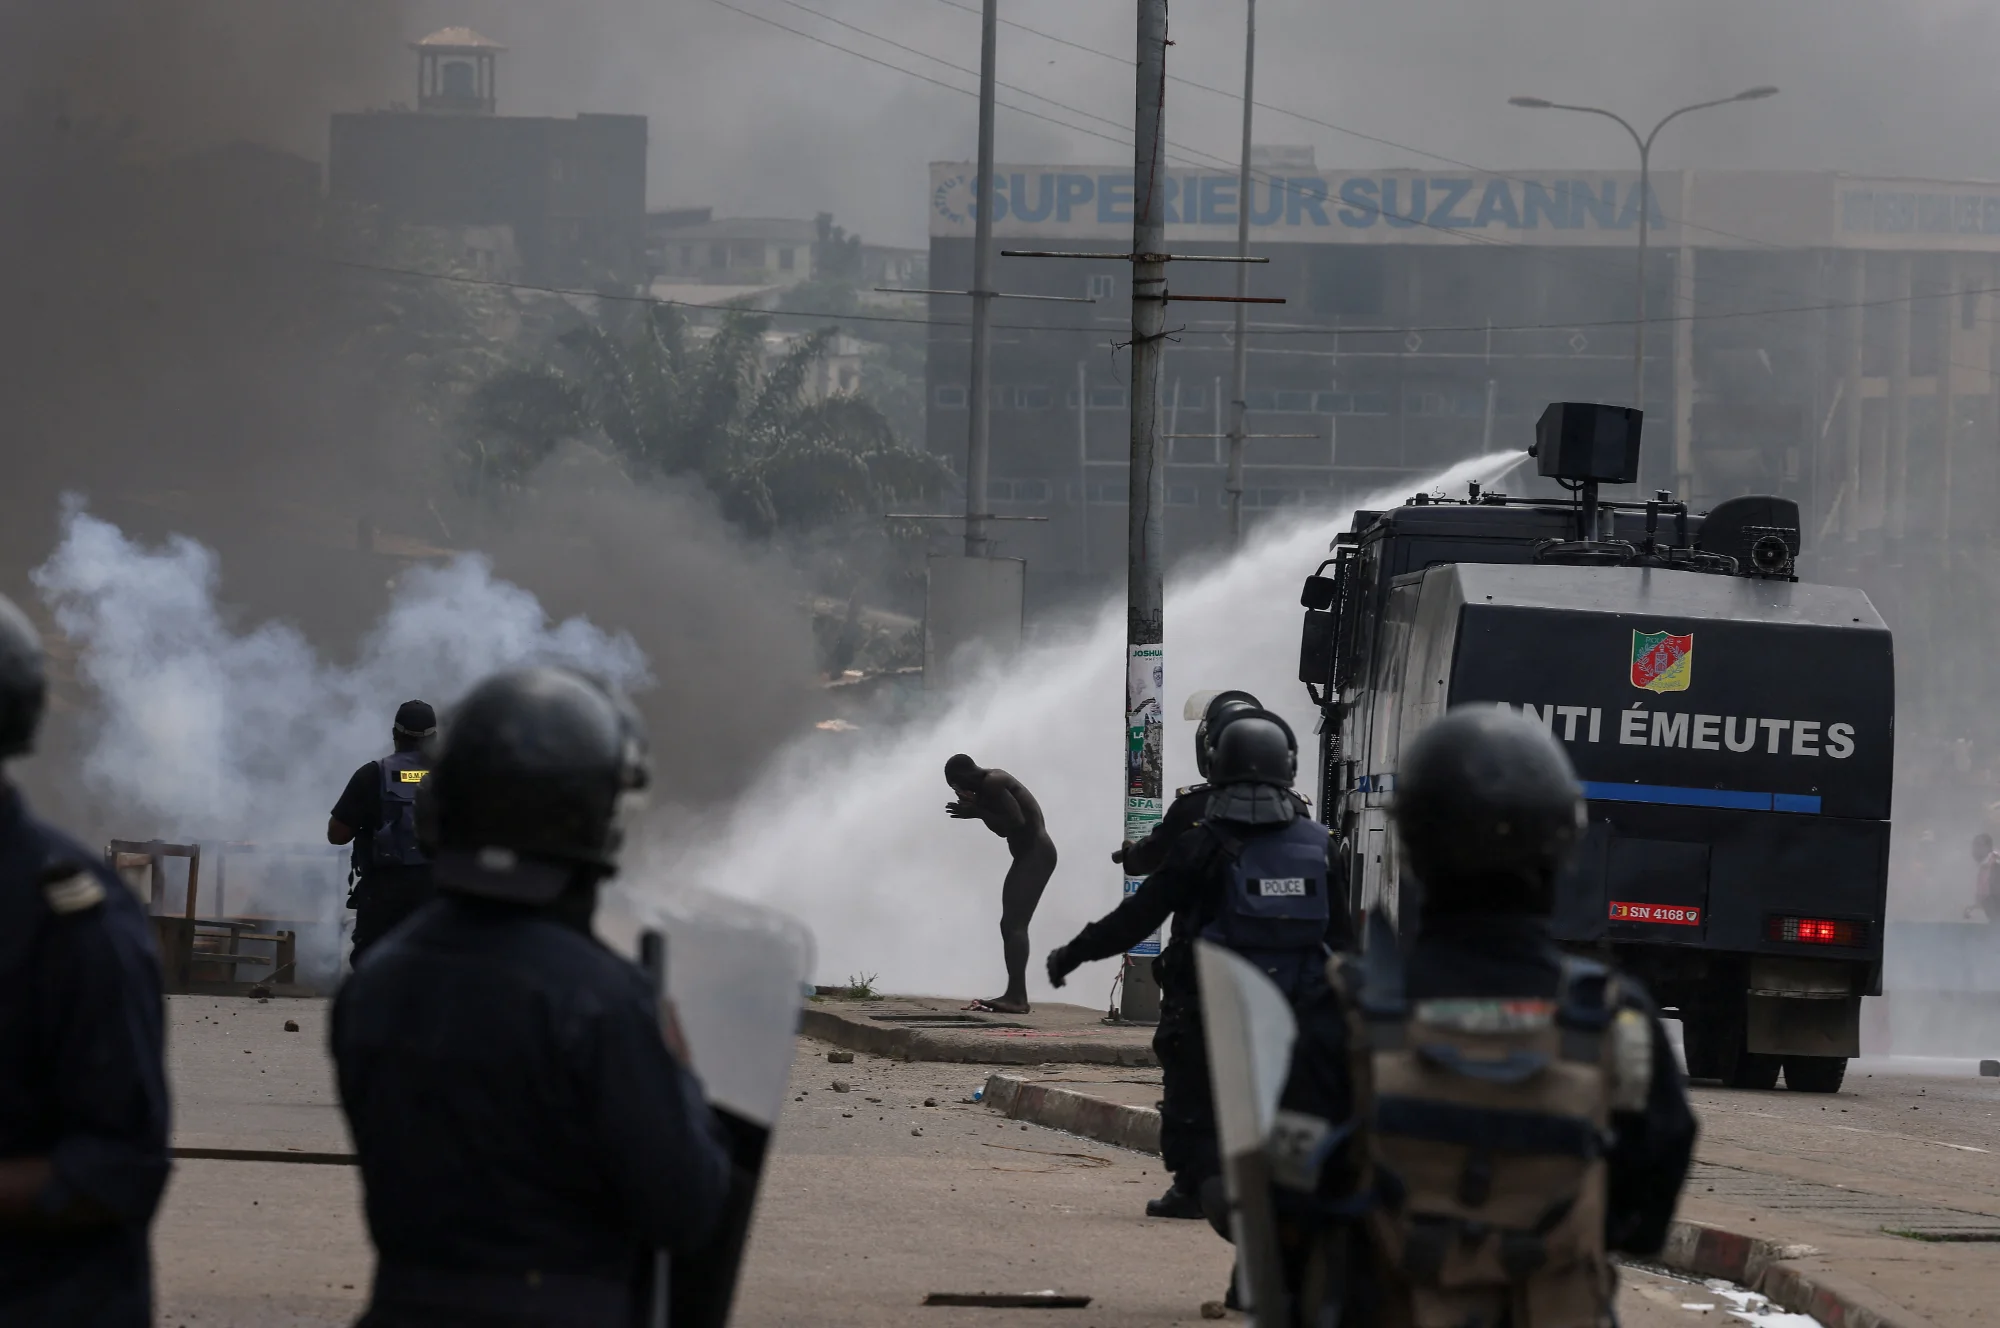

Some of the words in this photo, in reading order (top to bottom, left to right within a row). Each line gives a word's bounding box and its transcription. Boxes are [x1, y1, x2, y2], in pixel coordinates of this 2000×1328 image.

[1338, 177, 1666, 231] SUZANNA
[1618, 701, 1856, 759] ÉMEUTES
[1264, 880, 1302, 893] POLICE
[1630, 907, 1650, 918] SN
[1653, 908, 1684, 921] 4168
